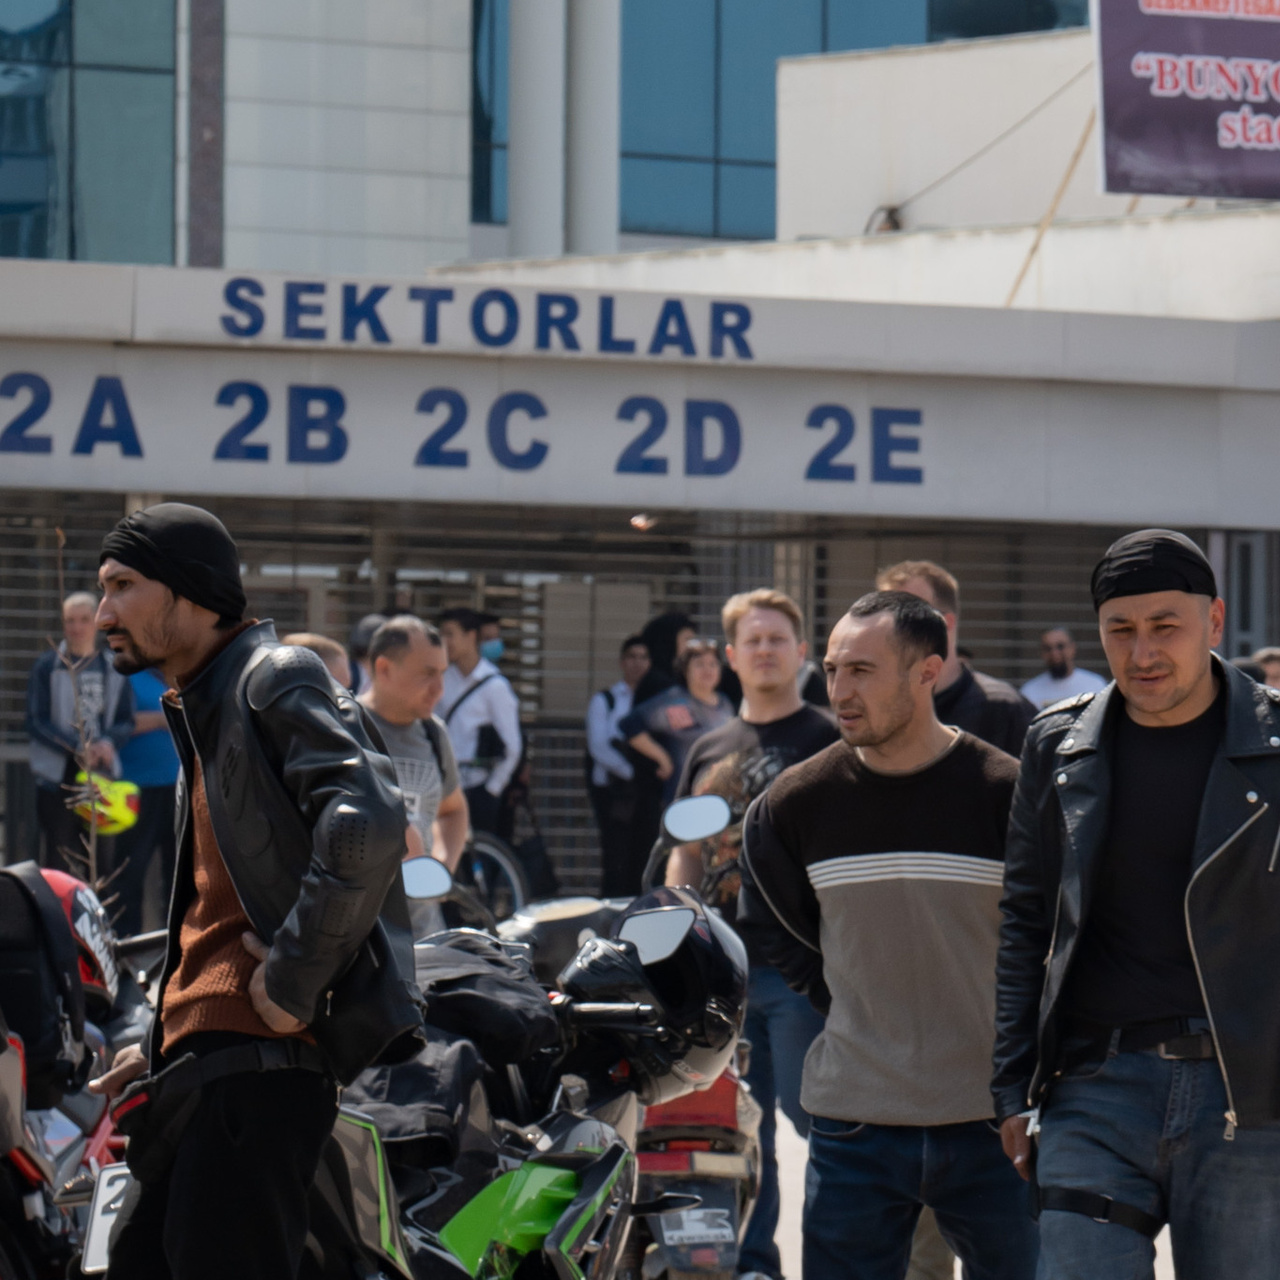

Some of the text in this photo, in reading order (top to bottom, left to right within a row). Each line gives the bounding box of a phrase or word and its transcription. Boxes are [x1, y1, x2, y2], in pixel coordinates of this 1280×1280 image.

[221, 277, 755, 362] SEKTORLAR
[0, 372, 924, 484] 2A 2B 2C 2D 2E
